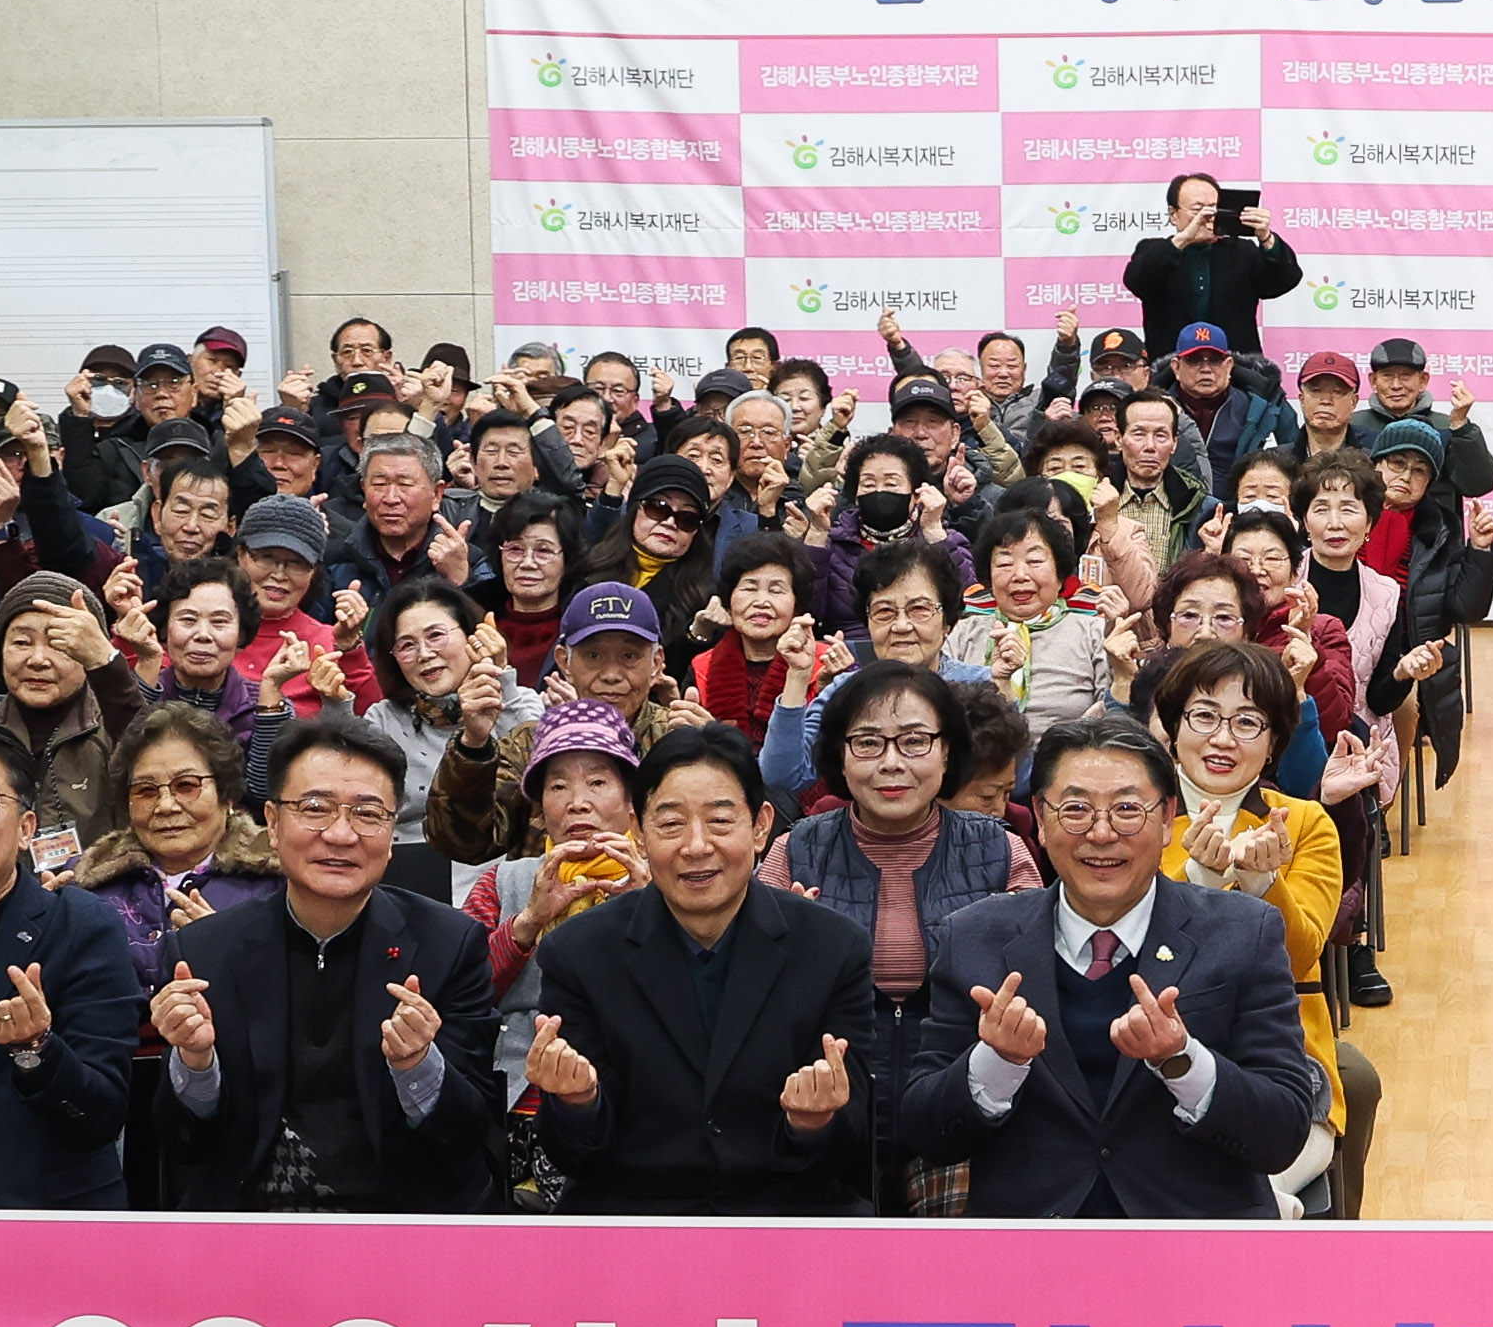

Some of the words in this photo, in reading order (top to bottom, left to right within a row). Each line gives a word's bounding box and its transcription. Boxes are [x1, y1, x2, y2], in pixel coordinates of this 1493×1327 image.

[570, 64, 695, 90] 김해시복지재단
[759, 63, 979, 88] 김해시동부노인종합복지관
[1088, 63, 1217, 87] 김해시복지재단
[509, 134, 722, 164] 김해시동부노인종합복지관
[828, 144, 955, 168] 김해시복지재단
[1023, 136, 1242, 161] 김해시동부노인종합복지관
[1348, 142, 1476, 166] 김해시복지재단
[576, 210, 700, 234] 김해시복지재단
[763, 210, 982, 233] 김해시동부노인종합복지관
[1091, 209, 1175, 233] 김해시복
[511, 279, 727, 306] 김해시동부노인종합복지관
[831, 288, 958, 313] 김해시복지재단
[1350, 287, 1476, 311] 김해시복지재단
[590, 596, 633, 614] FTV
